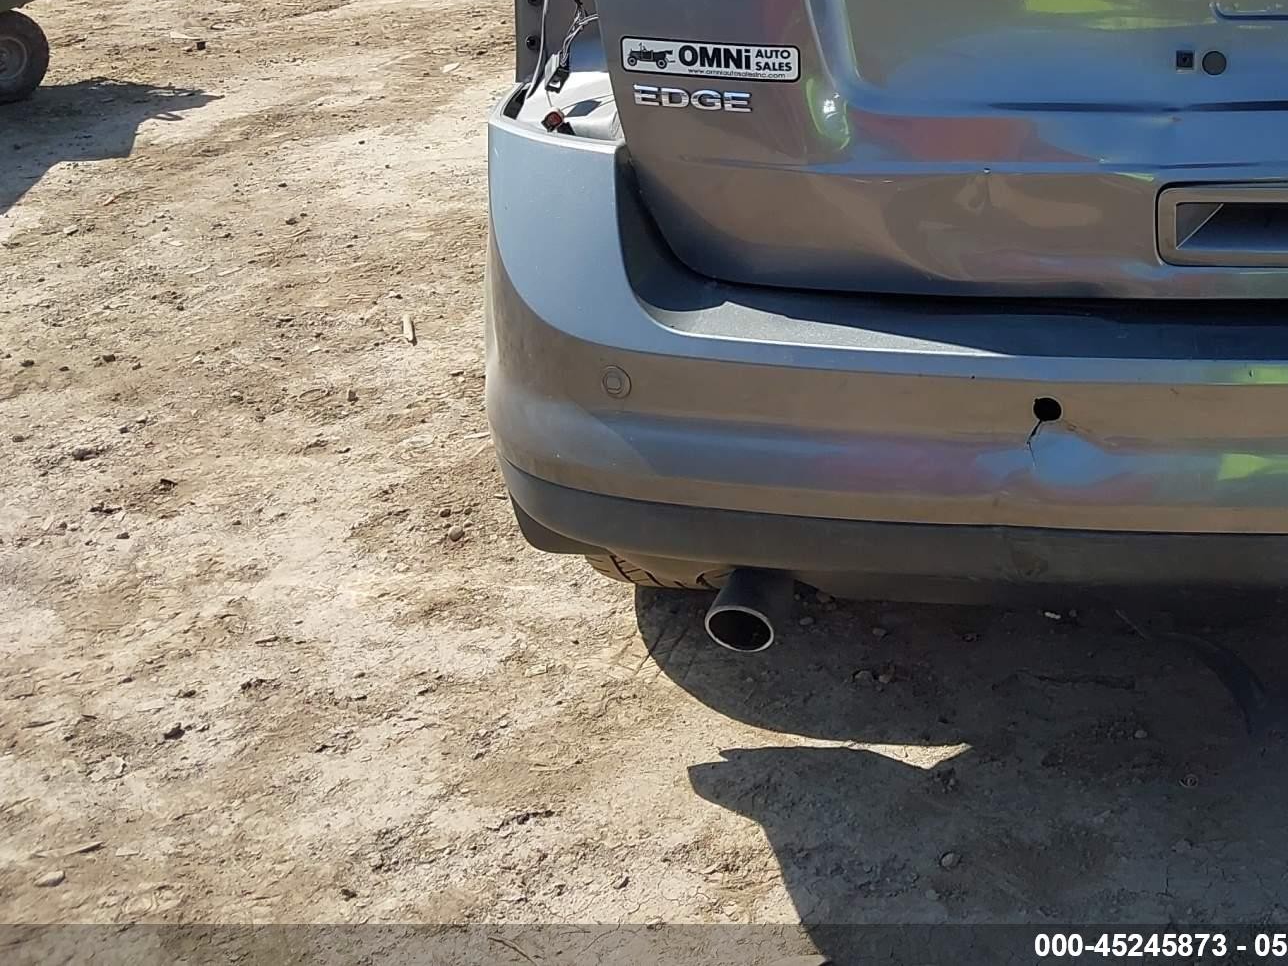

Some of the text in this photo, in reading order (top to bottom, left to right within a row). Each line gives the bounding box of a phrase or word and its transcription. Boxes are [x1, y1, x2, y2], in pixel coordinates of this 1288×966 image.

[754, 48, 792, 60] AUTO
[754, 61, 793, 72] SALES
[633, 83, 753, 113] EDGE
